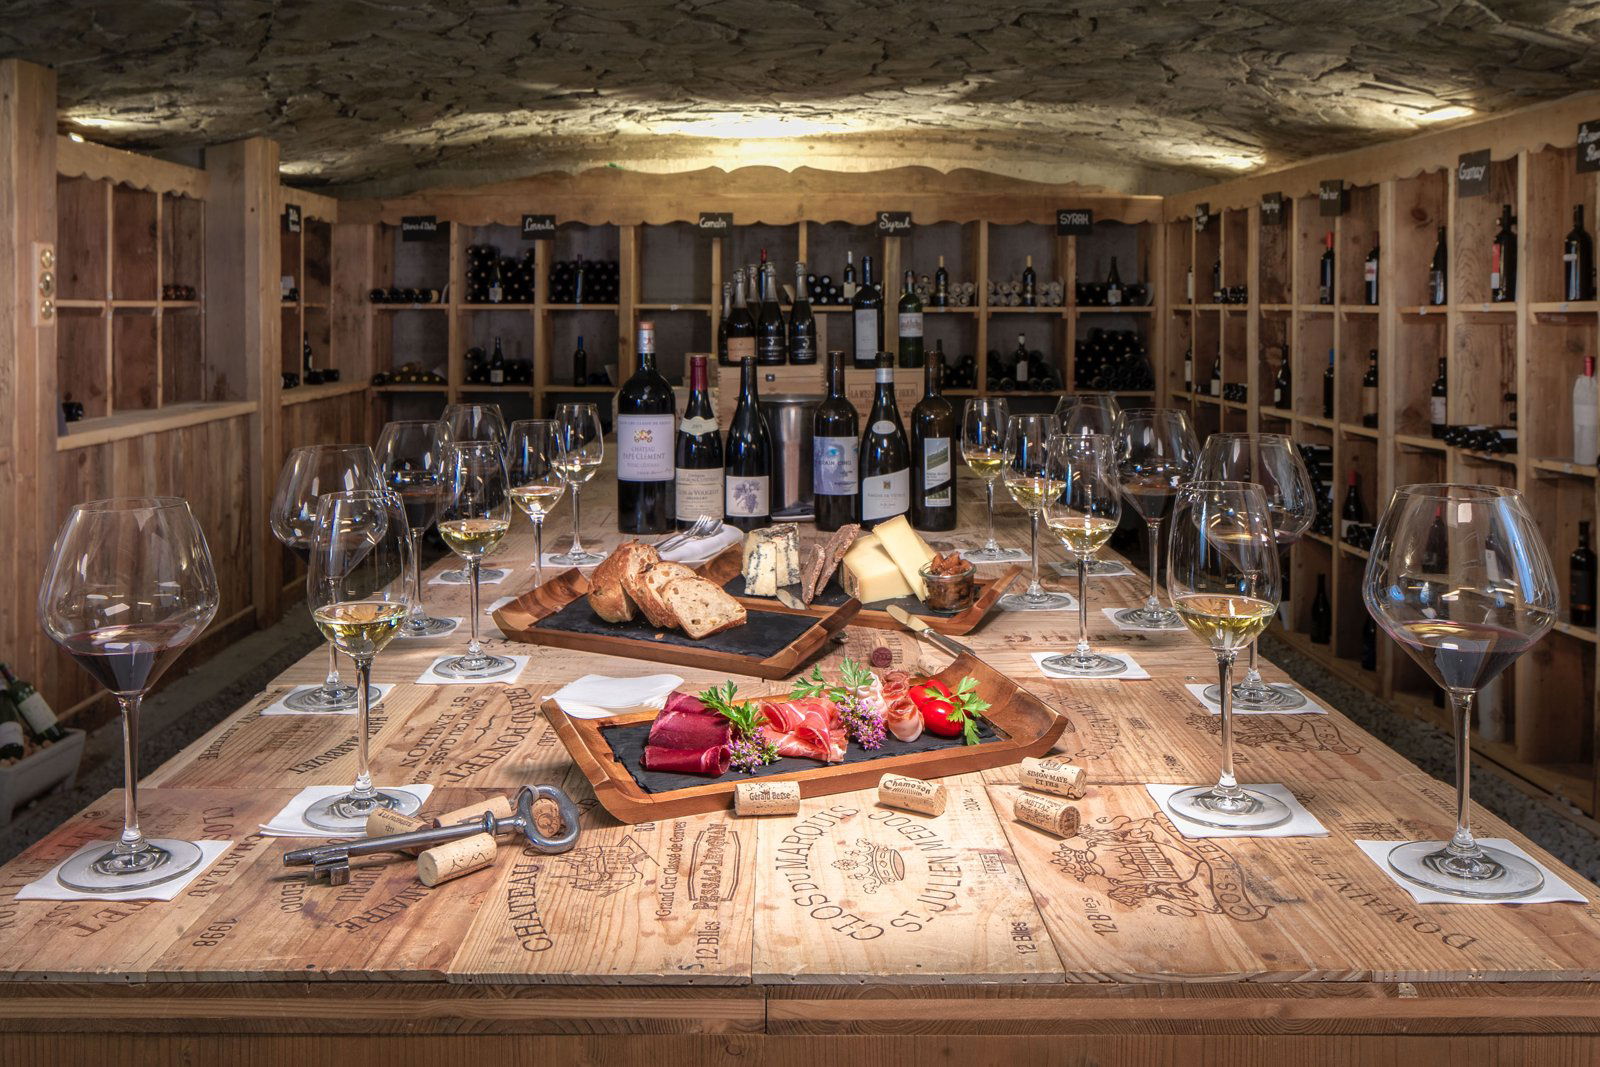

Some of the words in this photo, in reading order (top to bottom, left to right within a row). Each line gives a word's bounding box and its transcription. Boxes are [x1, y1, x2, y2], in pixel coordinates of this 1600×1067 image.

[879, 212, 912, 230] Syrah
[1060, 212, 1090, 225] SYRAH
[503, 687, 536, 723] GRAND
[398, 713, 455, 768] EMILION
[440, 726, 531, 783] PONTET
[883, 780, 931, 794] Chamoson
[669, 821, 687, 844] Graves
[775, 805, 860, 870] MARQUIS
[868, 810, 951, 851] MEDOC
[188, 833, 269, 898] CHATEAU
[663, 854, 681, 876] Classé
[671, 845, 683, 856] de
[917, 855, 963, 913] JULIEN
[334, 879, 431, 934] ANAIRE
[508, 864, 553, 952] CHATEAU
[655, 888, 675, 917] Grand
[1316, 871, 1477, 950] DOMAINE
[192, 918, 238, 948] 1998
[1015, 943, 1038, 955] 12
[695, 948, 719, 961] 12
